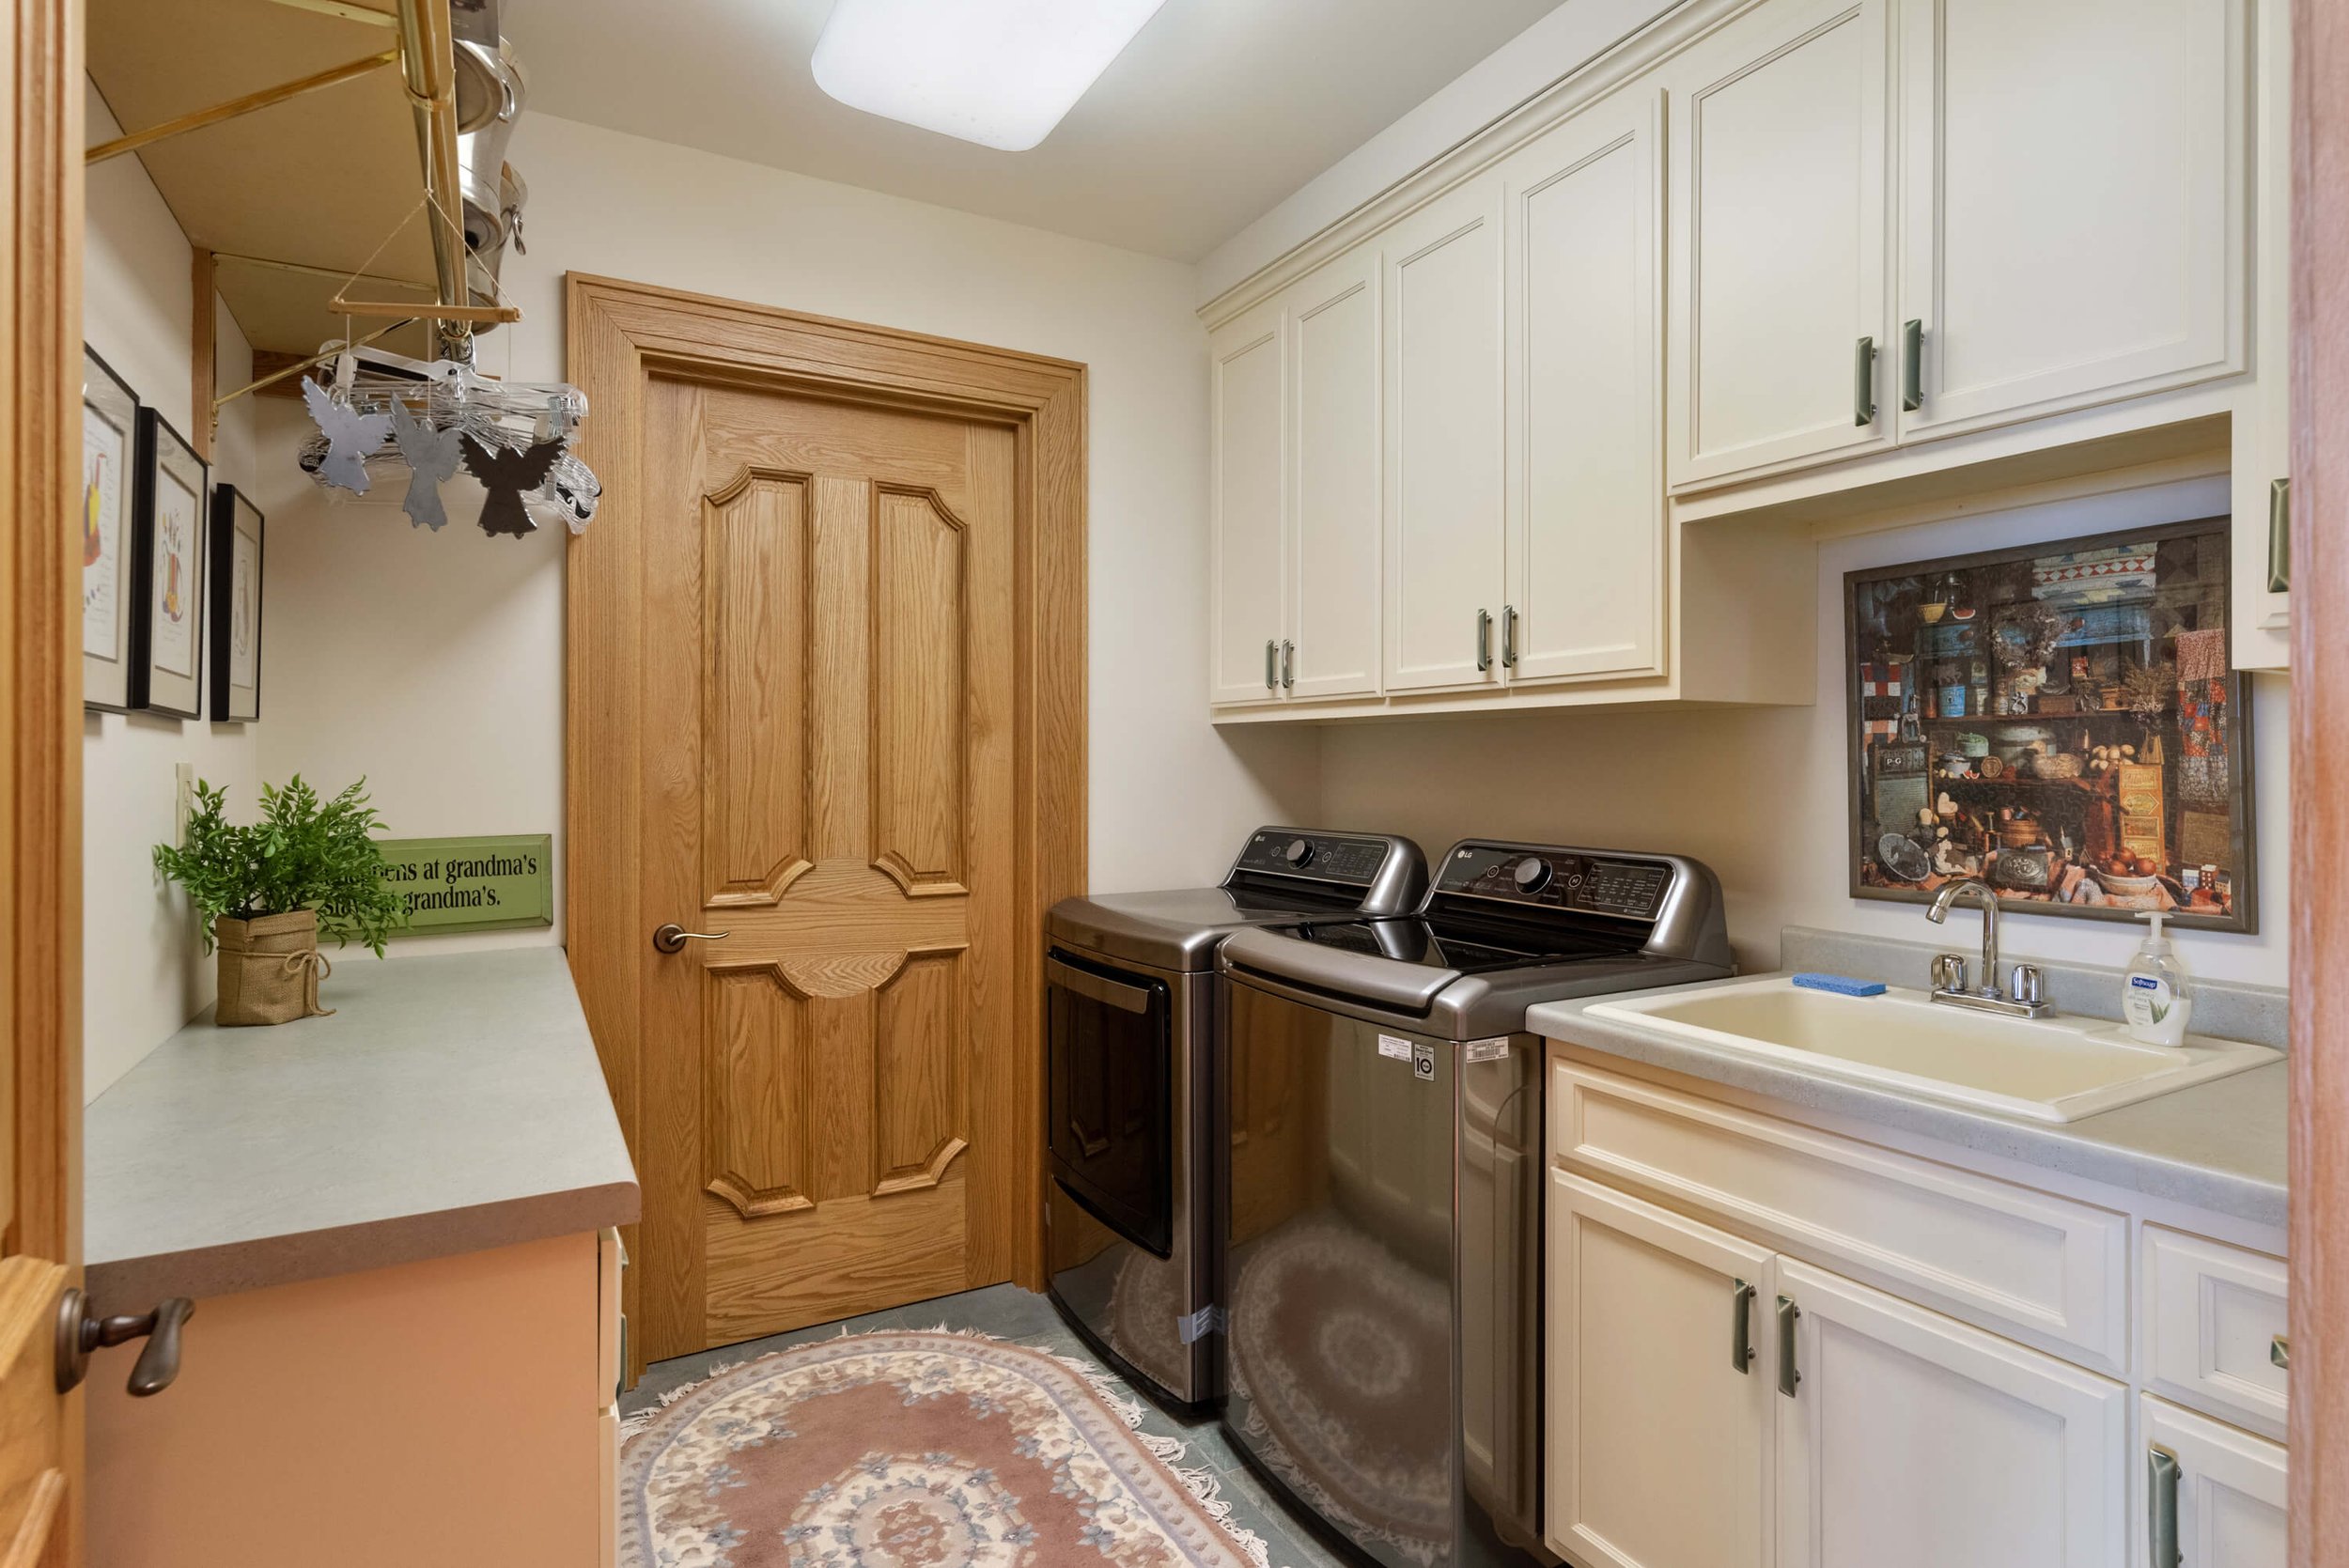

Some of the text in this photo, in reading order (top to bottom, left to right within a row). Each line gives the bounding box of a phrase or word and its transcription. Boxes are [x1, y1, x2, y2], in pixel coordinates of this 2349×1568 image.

[423, 859, 439, 879] at
[445, 854, 537, 885] grandma's
[402, 885, 501, 916] grandma's.
[1417, 1057, 1432, 1074] 10
